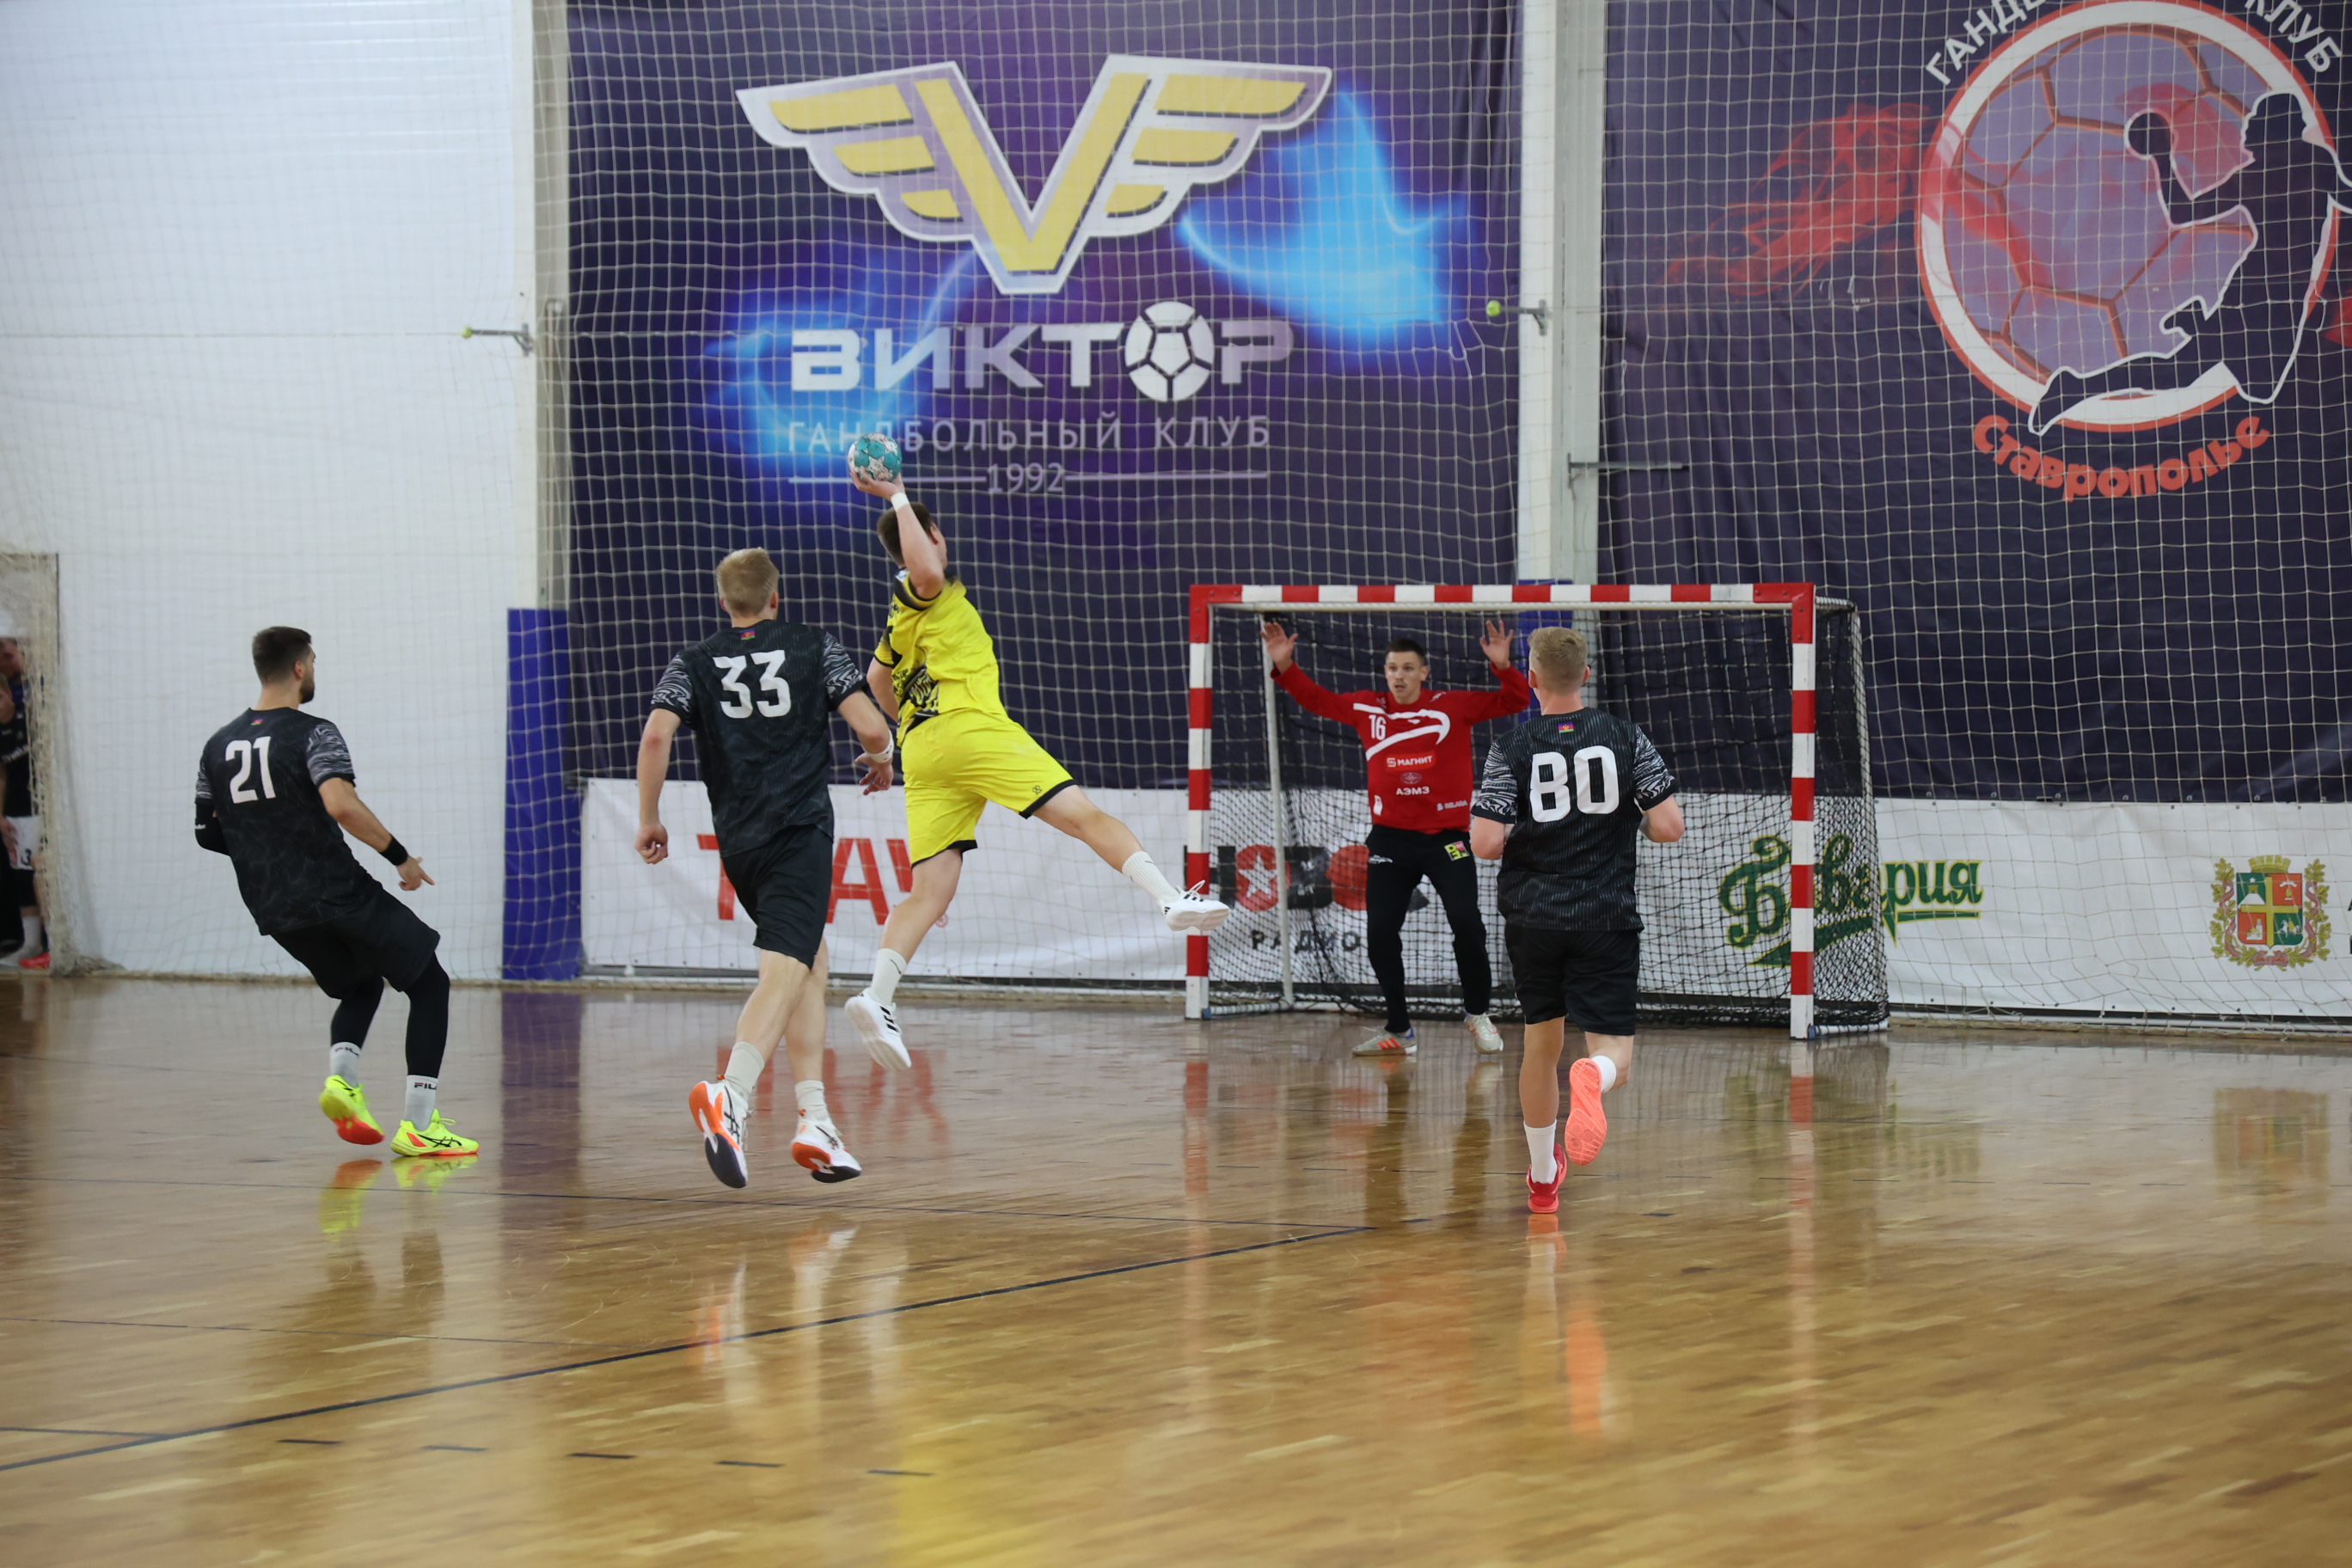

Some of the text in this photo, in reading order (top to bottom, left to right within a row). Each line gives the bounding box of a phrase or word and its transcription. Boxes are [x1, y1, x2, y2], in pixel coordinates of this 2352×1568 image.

[791, 301, 1294, 402] ВИКТОР
[1155, 414, 1270, 448] КЛУБ
[1973, 415, 2270, 502] Ставрополье
[986, 462, 1065, 493] 1992
[713, 649, 791, 719] 33
[1369, 714, 1387, 740] 16
[1397, 756, 1433, 766] МАГНИТ
[224, 736, 277, 804] 21
[1396, 786, 1430, 795] АЭМЗ
[1529, 745, 1620, 823] 80
[1718, 834, 1984, 948] Бвария
